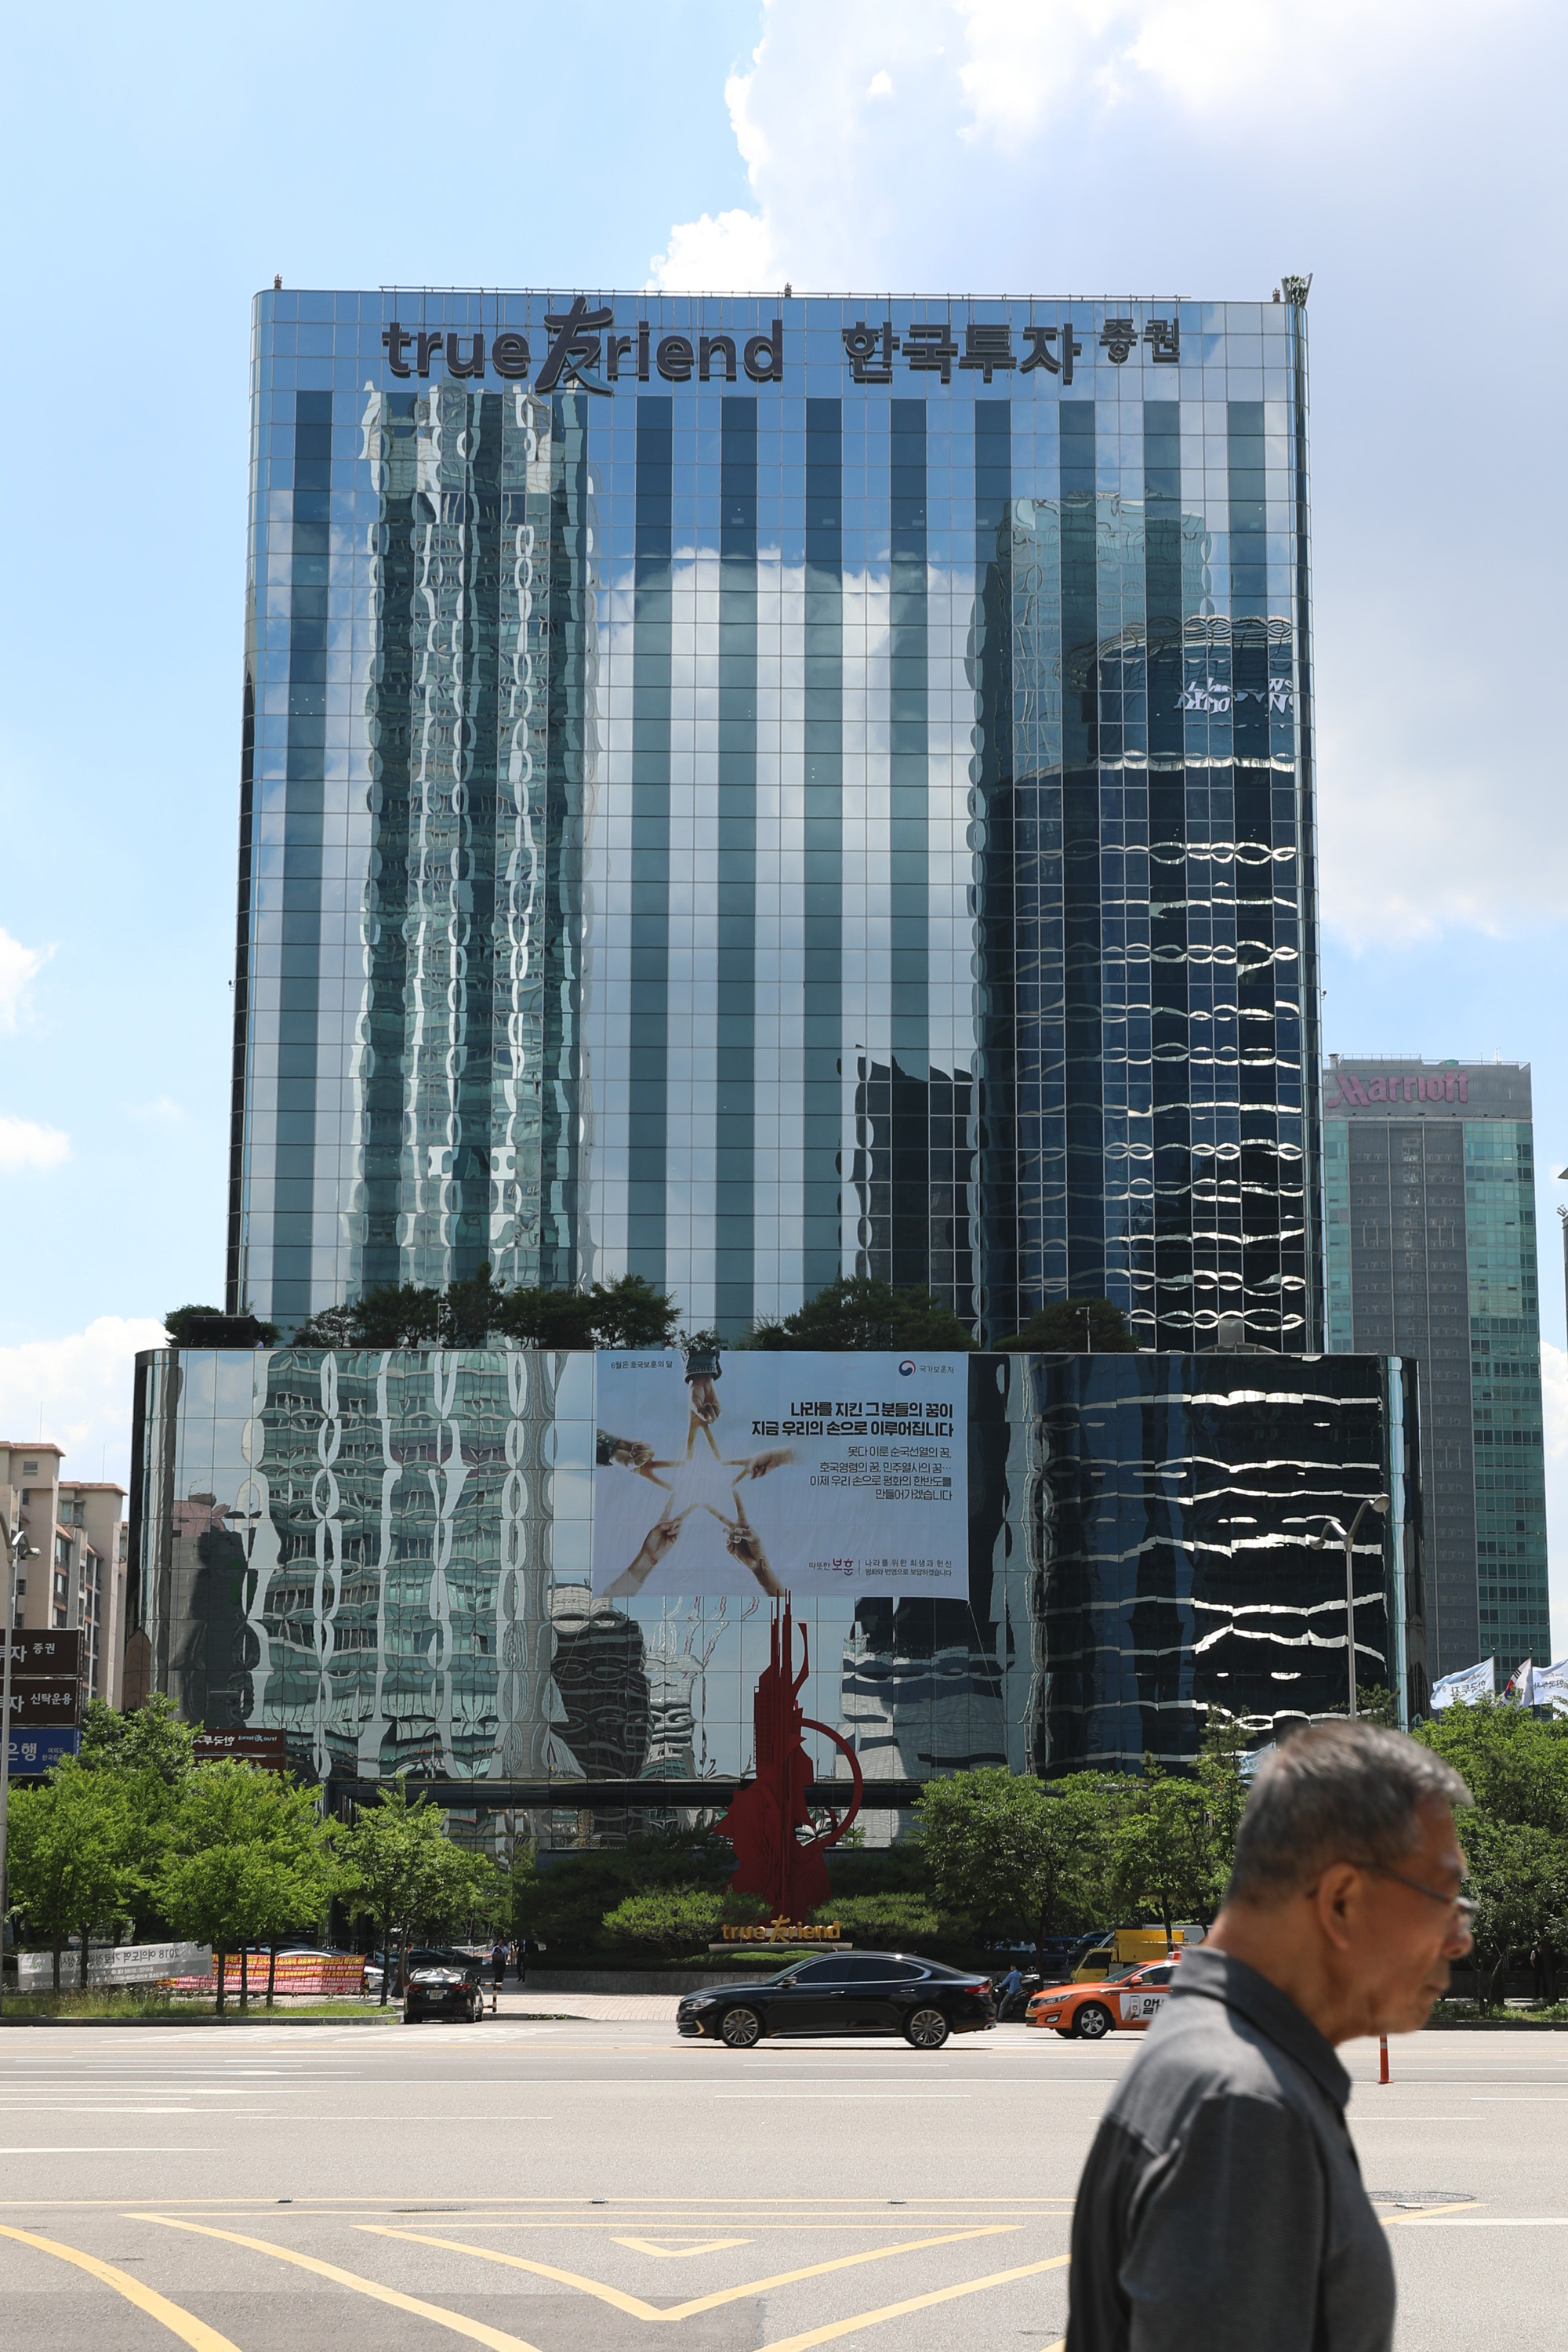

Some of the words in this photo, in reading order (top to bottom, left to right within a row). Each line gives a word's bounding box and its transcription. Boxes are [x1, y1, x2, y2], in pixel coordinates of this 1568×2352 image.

[842, 321, 1083, 386] 한국투자
[1099, 318, 1180, 364] 증권
[1326, 1070, 1469, 1109] Marriott
[611, 1360, 629, 1370] 6월은
[630, 1360, 665, 1369] 호국보훈의
[666, 1360, 673, 1369] 달
[919, 1364, 955, 1375] 국가보훈처
[790, 1402, 833, 1417] 나라를
[835, 1402, 863, 1417] 지킨
[865, 1402, 880, 1417] 그
[881, 1402, 923, 1418] 분들의
[925, 1403, 953, 1419] 꿈이
[751, 1421, 780, 1436] 지금
[782, 1421, 824, 1436] 우리의
[826, 1421, 869, 1436] 손으로
[870, 1421, 954, 1438] 이루어집니다
[848, 1446, 869, 1457] 못다
[869, 1446, 889, 1458] 이룬
[890, 1446, 938, 1458] 순국선열의
[940, 1447, 952, 1459] 꿈,
[819, 1462, 868, 1474] 호국영령의
[869, 1462, 882, 1474] 꿈,
[883, 1462, 931, 1474] 민주열사의
[810, 1475, 829, 1486] 이제
[831, 1475, 851, 1486] 우리
[852, 1475, 882, 1486] 손으로
[883, 1475, 912, 1487] 평화의
[913, 1476, 953, 1488] 한반도를
[875, 1489, 953, 1501] 만들어가겠습니다
[808, 1562, 831, 1571] 따뜻한
[832, 1558, 854, 1577] 보훈
[865, 1559, 889, 1567] 나라를
[891, 1559, 907, 1567] 위한
[909, 1559, 934, 1567] 희생과
[32, 1642, 56, 1655] 증권
[30, 1693, 72, 1705] 신탁운용
[0, 1742, 38, 1762] 은행
